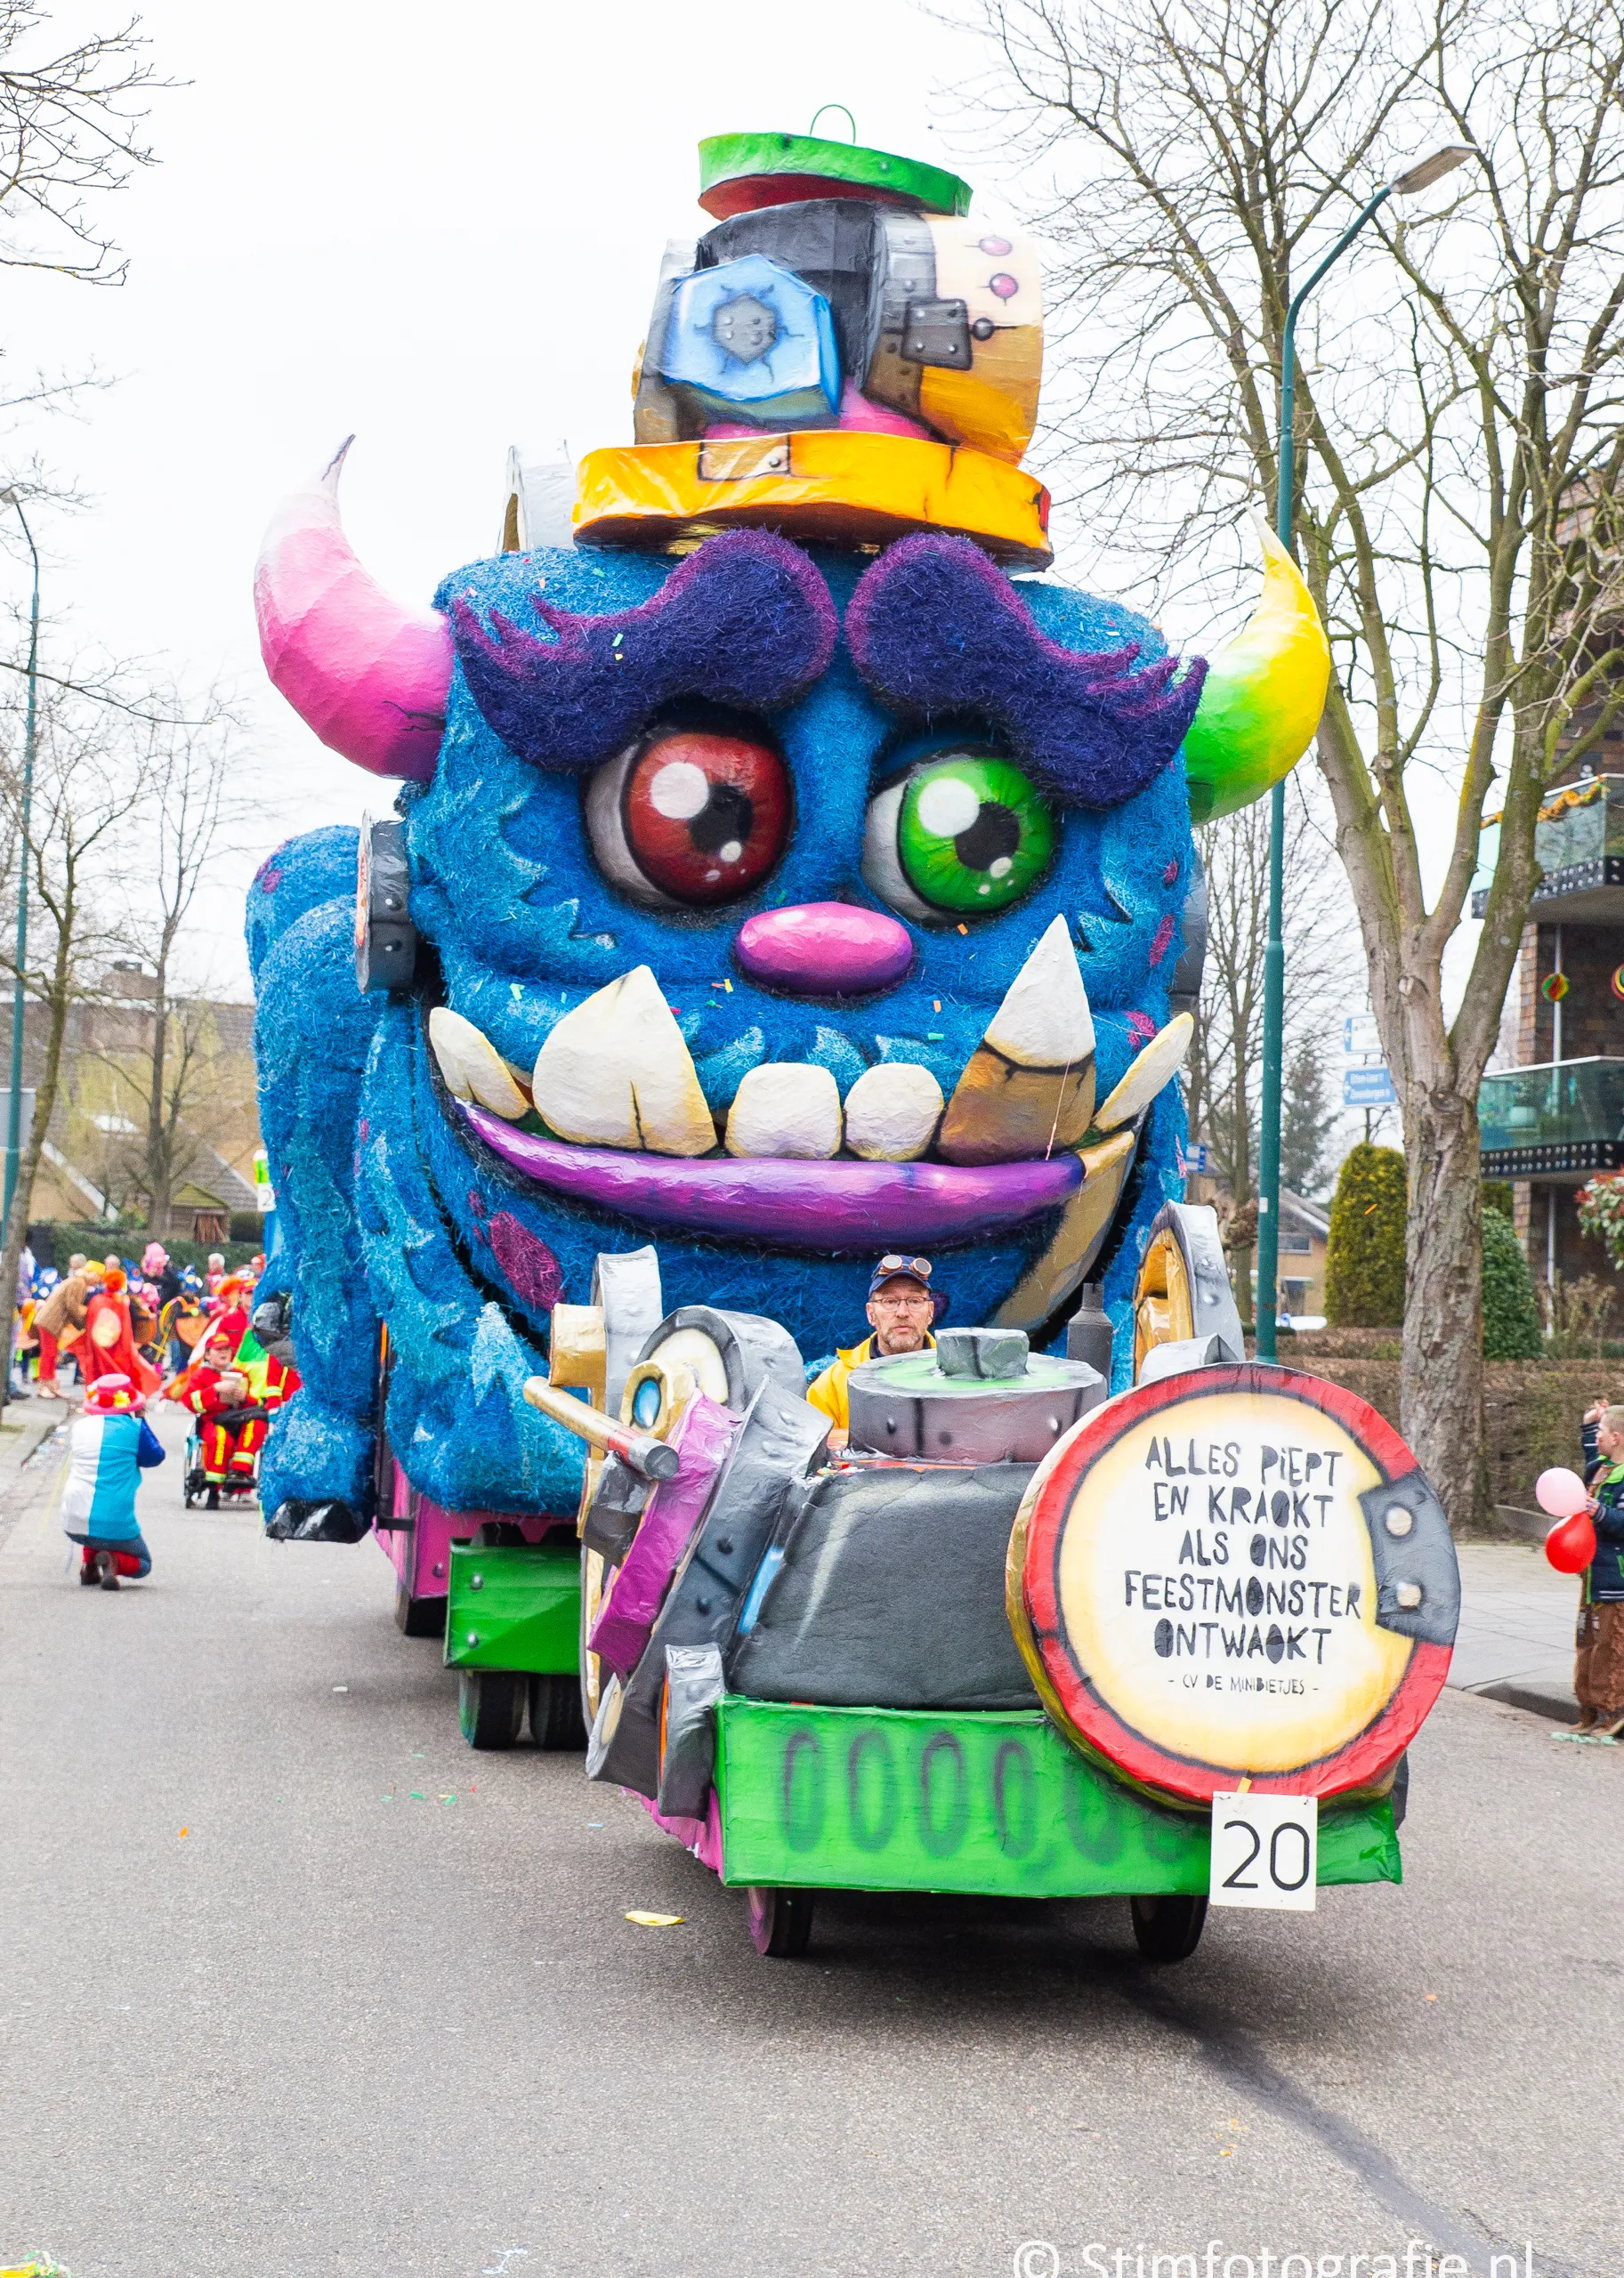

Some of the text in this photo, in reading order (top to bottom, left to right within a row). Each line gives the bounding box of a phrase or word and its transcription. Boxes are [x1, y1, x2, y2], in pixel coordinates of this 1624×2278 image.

[1145, 1435, 1240, 1478] ALLES
[1153, 1482, 1189, 1521] EN
[1178, 1529, 1309, 1571] ALS ONS
[1124, 1570, 1361, 1620] FEESTMONSTER
[1182, 1674, 1199, 1689] CV
[1206, 1674, 1223, 1691] DE
[1221, 1820, 1311, 1891] 20
